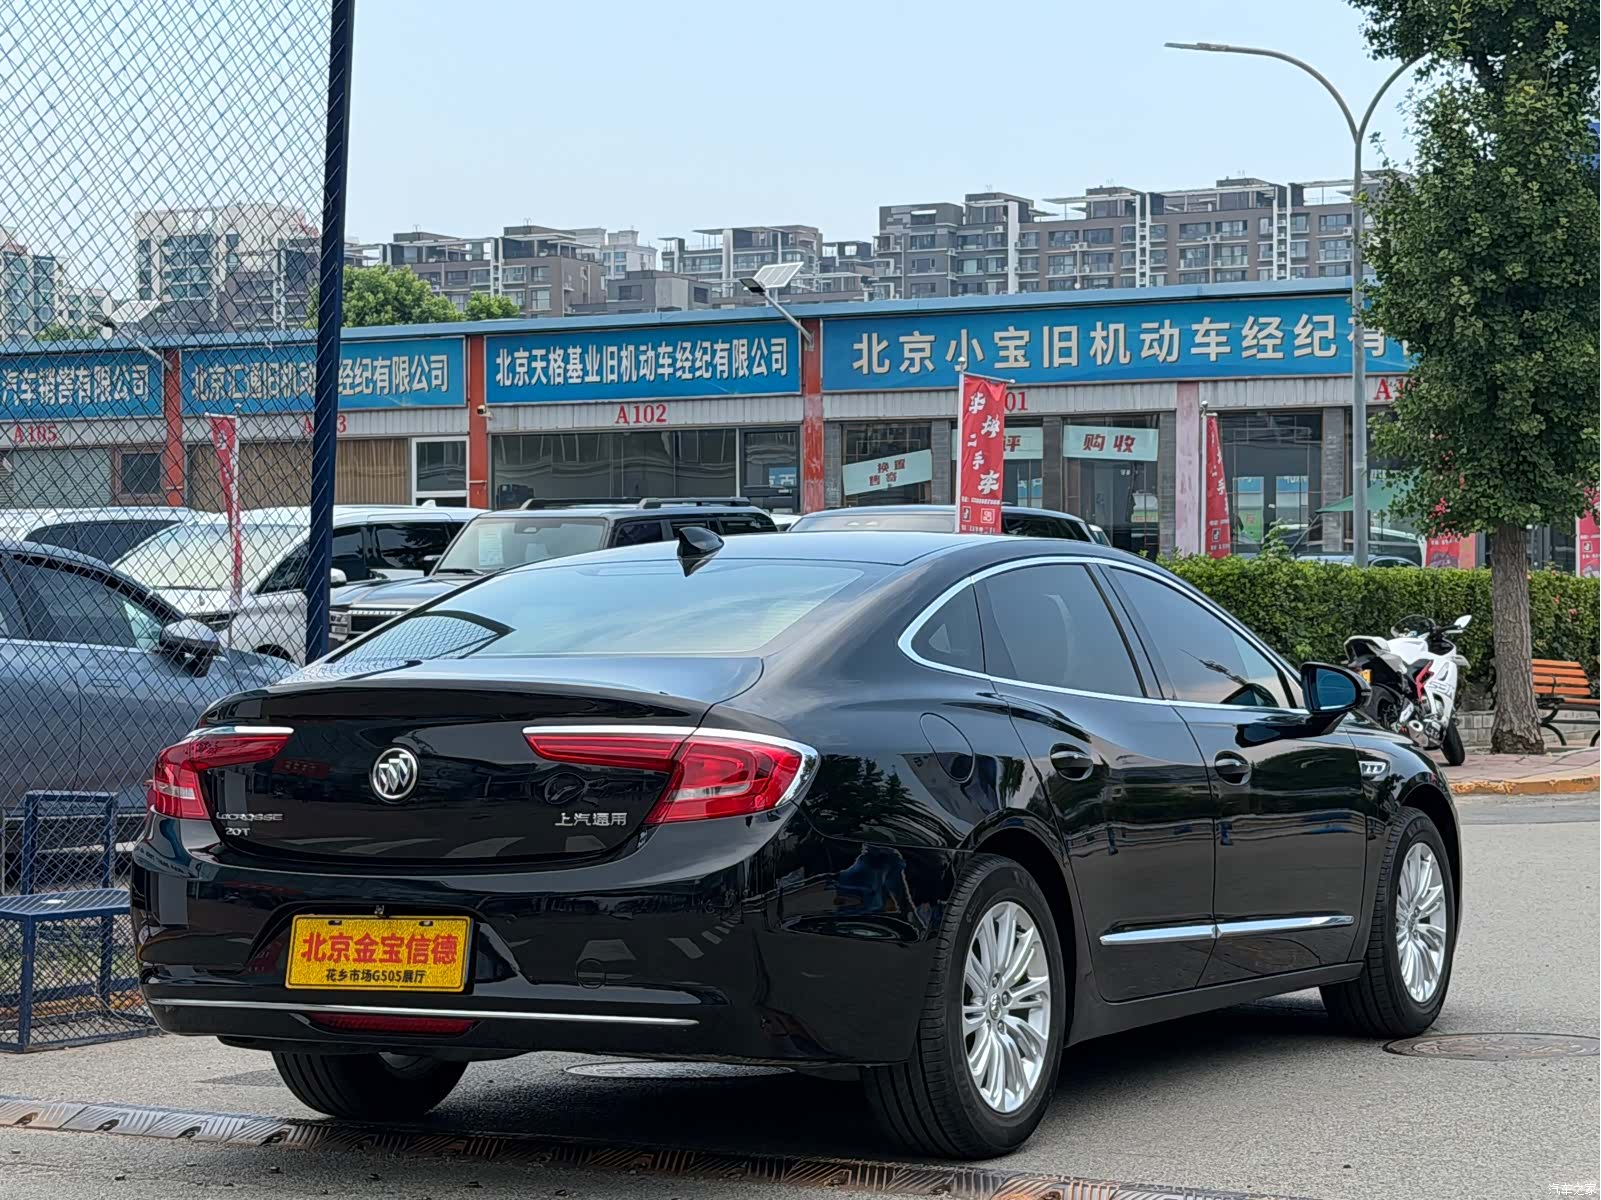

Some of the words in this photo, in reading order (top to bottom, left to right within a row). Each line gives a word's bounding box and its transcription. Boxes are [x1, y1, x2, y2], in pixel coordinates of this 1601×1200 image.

[852, 313, 1409, 375] 北京小宝旧机动车经纪有
[495, 336, 788, 388] 北京天格基业旧机动车经纪有限公司
[191, 355, 448, 401] 北京汇通旧机动经纪有限公司
[614, 403, 667, 425] A102
[13, 423, 58, 443] A105
[554, 812, 628, 826] 上汽通用
[301, 931, 459, 965] 北京金宝信德
[326, 968, 427, 984] 花乡市场G505展厅
